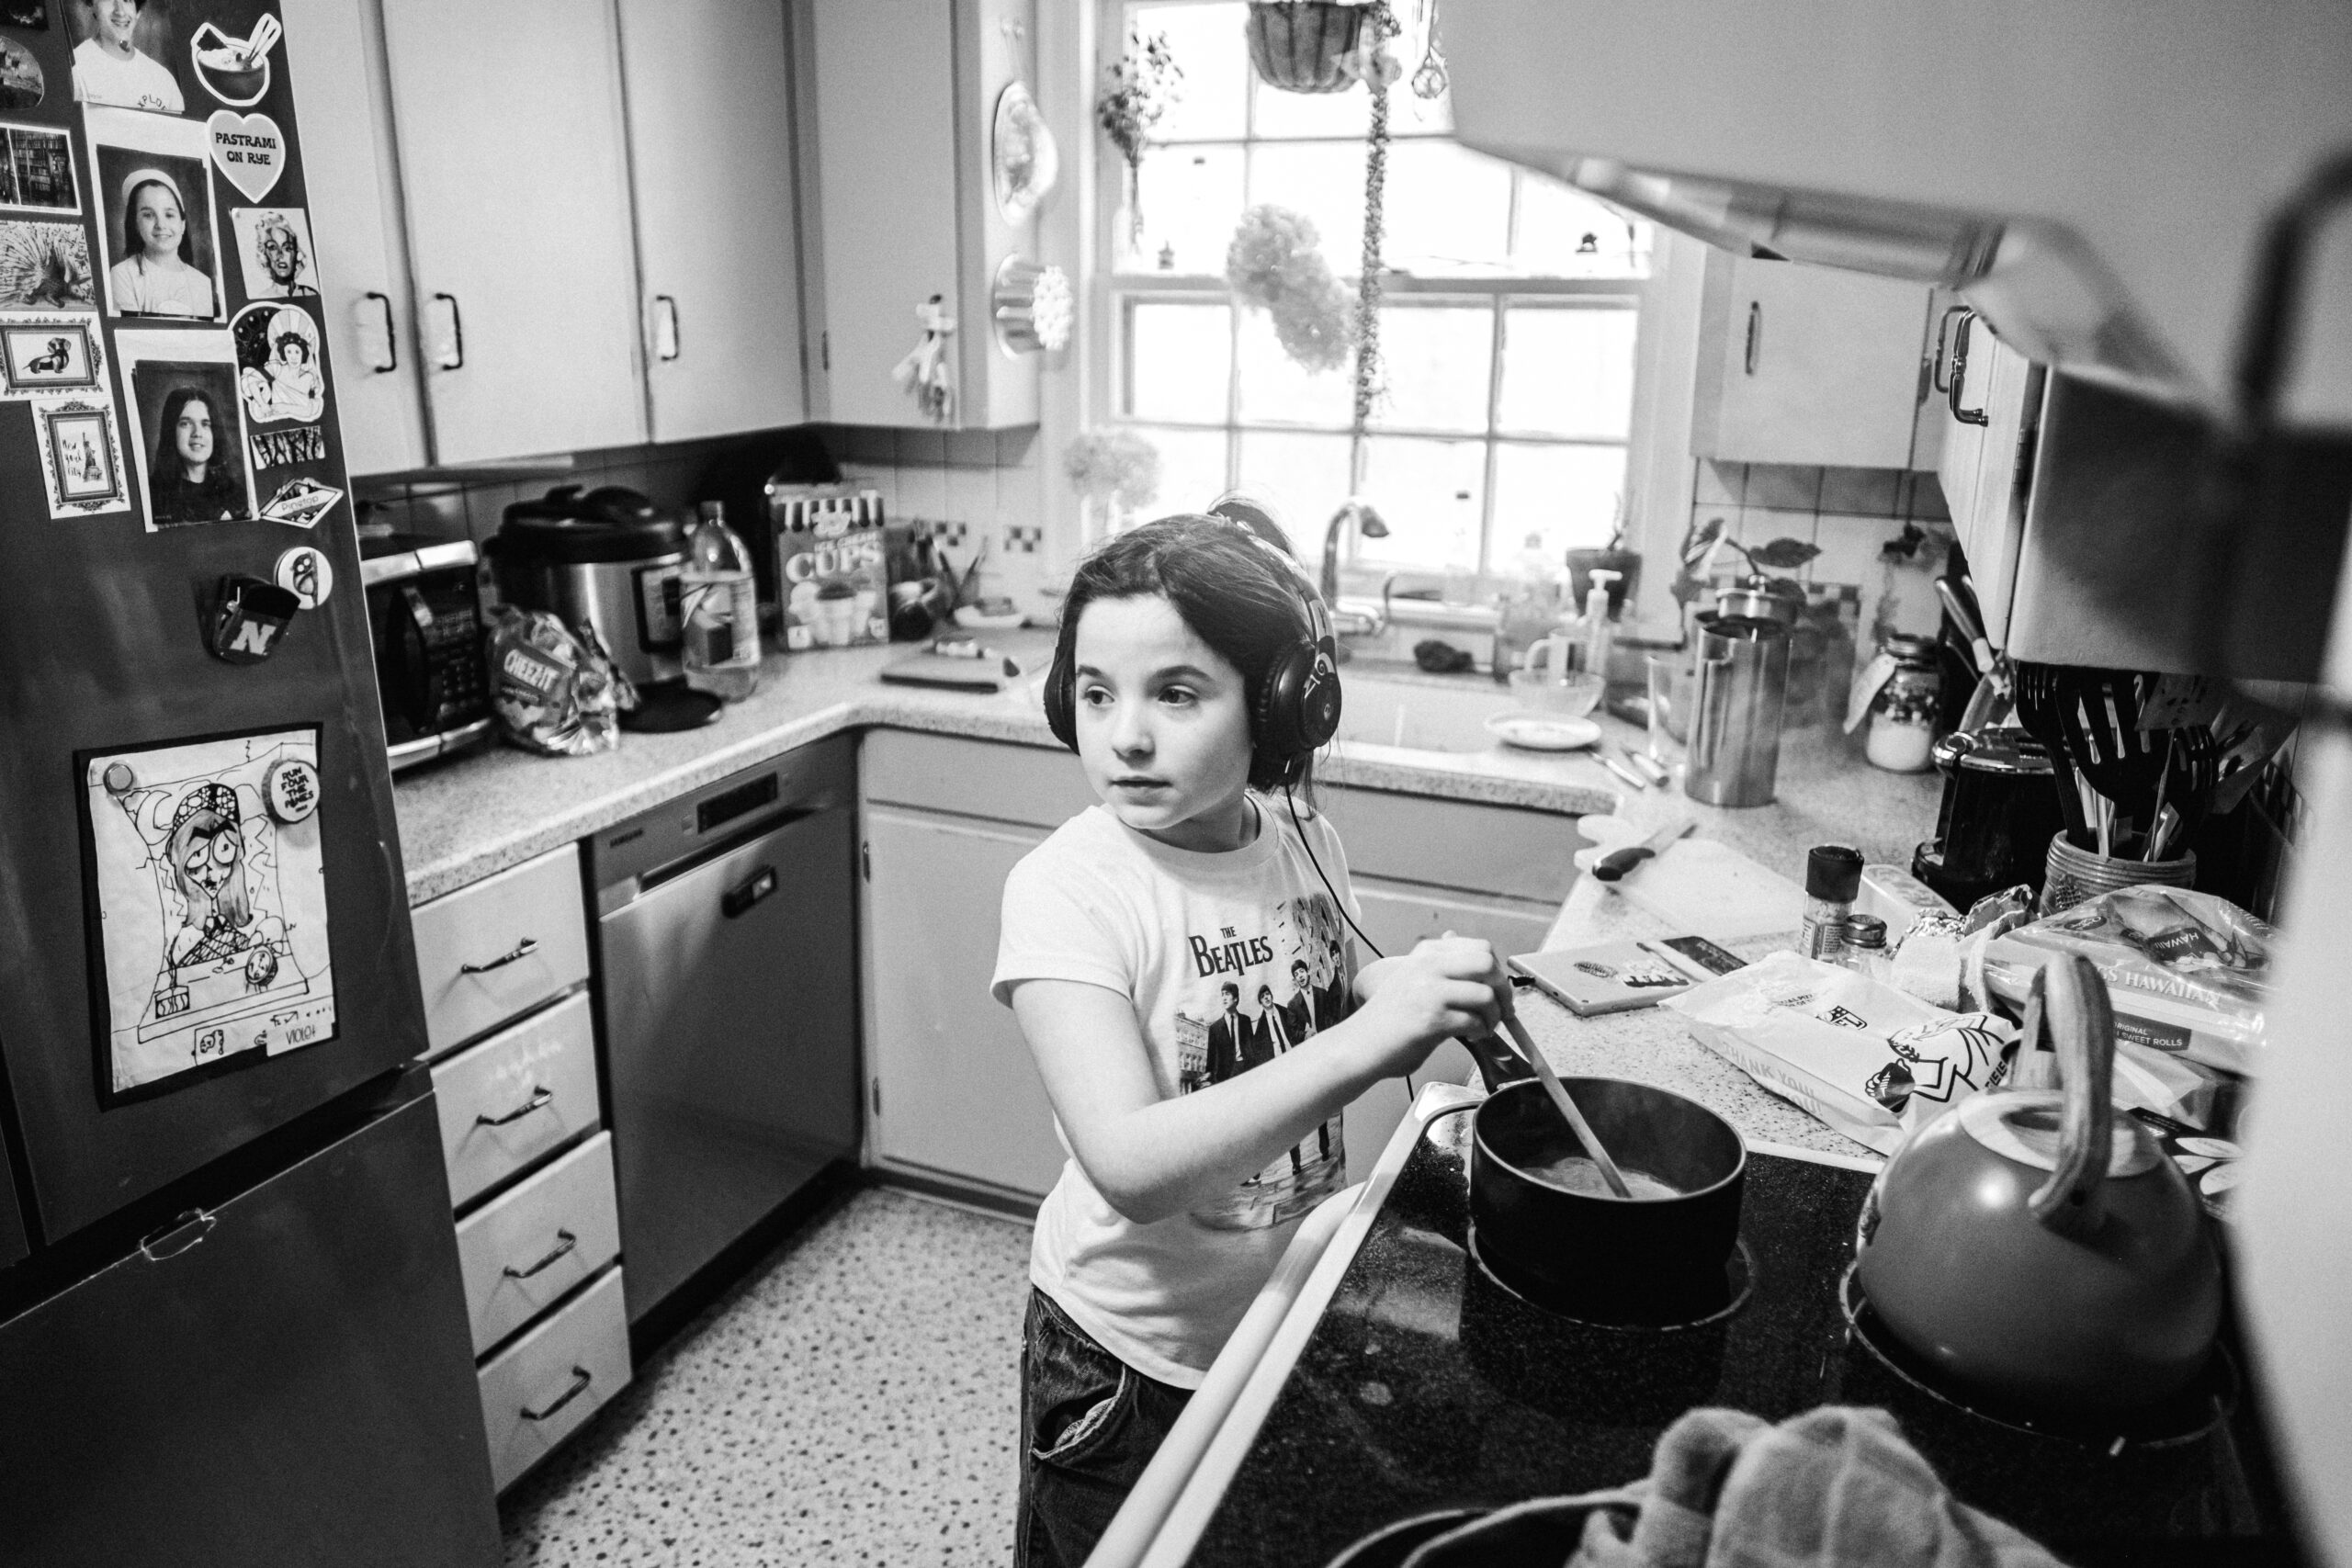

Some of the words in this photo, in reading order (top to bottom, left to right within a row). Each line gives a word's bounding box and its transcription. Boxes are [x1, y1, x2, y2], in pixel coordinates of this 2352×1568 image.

[215, 132, 277, 149] PASTRAMI
[226, 151, 243, 163] ON
[247, 152, 271, 165] RYE
[230, 619, 277, 655] N
[281, 766, 301, 781] RUN
[1219, 926, 1237, 939] THE
[1188, 934, 1273, 977] BEATLES
[2122, 1032, 2151, 1045] SWEET
[2154, 1038, 2184, 1047] ROLLS
